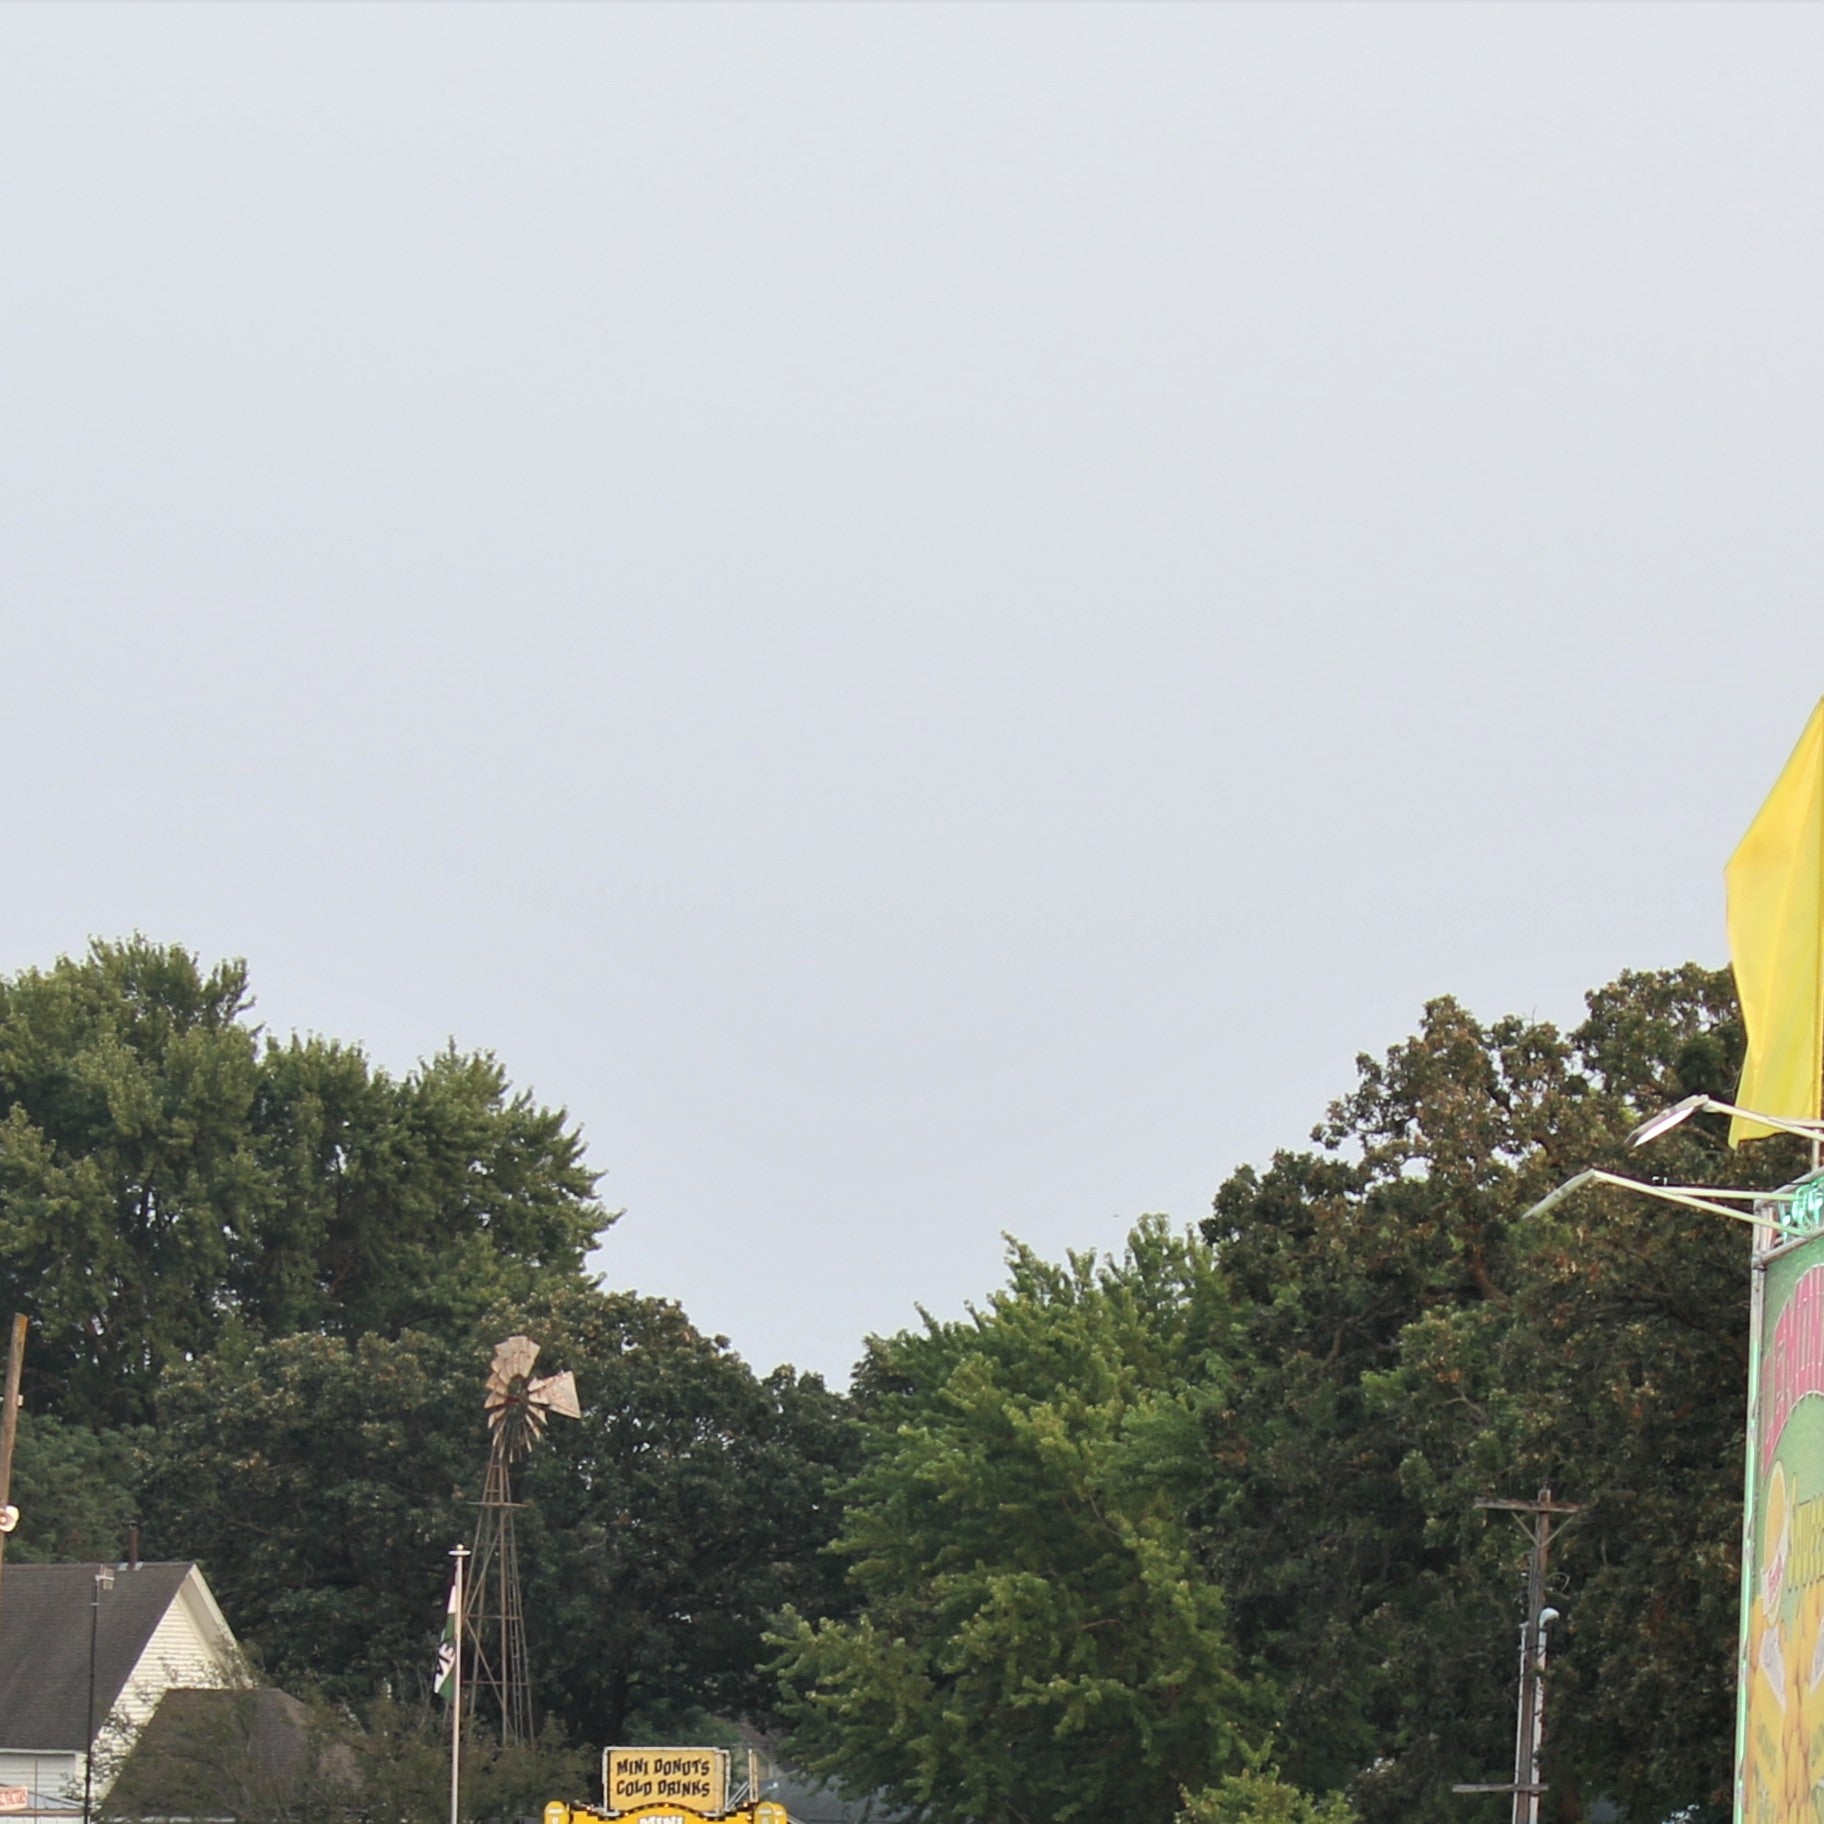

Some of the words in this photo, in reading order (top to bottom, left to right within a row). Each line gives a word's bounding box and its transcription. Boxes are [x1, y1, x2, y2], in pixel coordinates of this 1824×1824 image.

[616, 1759, 649, 1775] MINI
[654, 1757, 711, 1776] DONUTS
[616, 1779, 652, 1797] COLD
[658, 1778, 711, 1798] DRINKS
